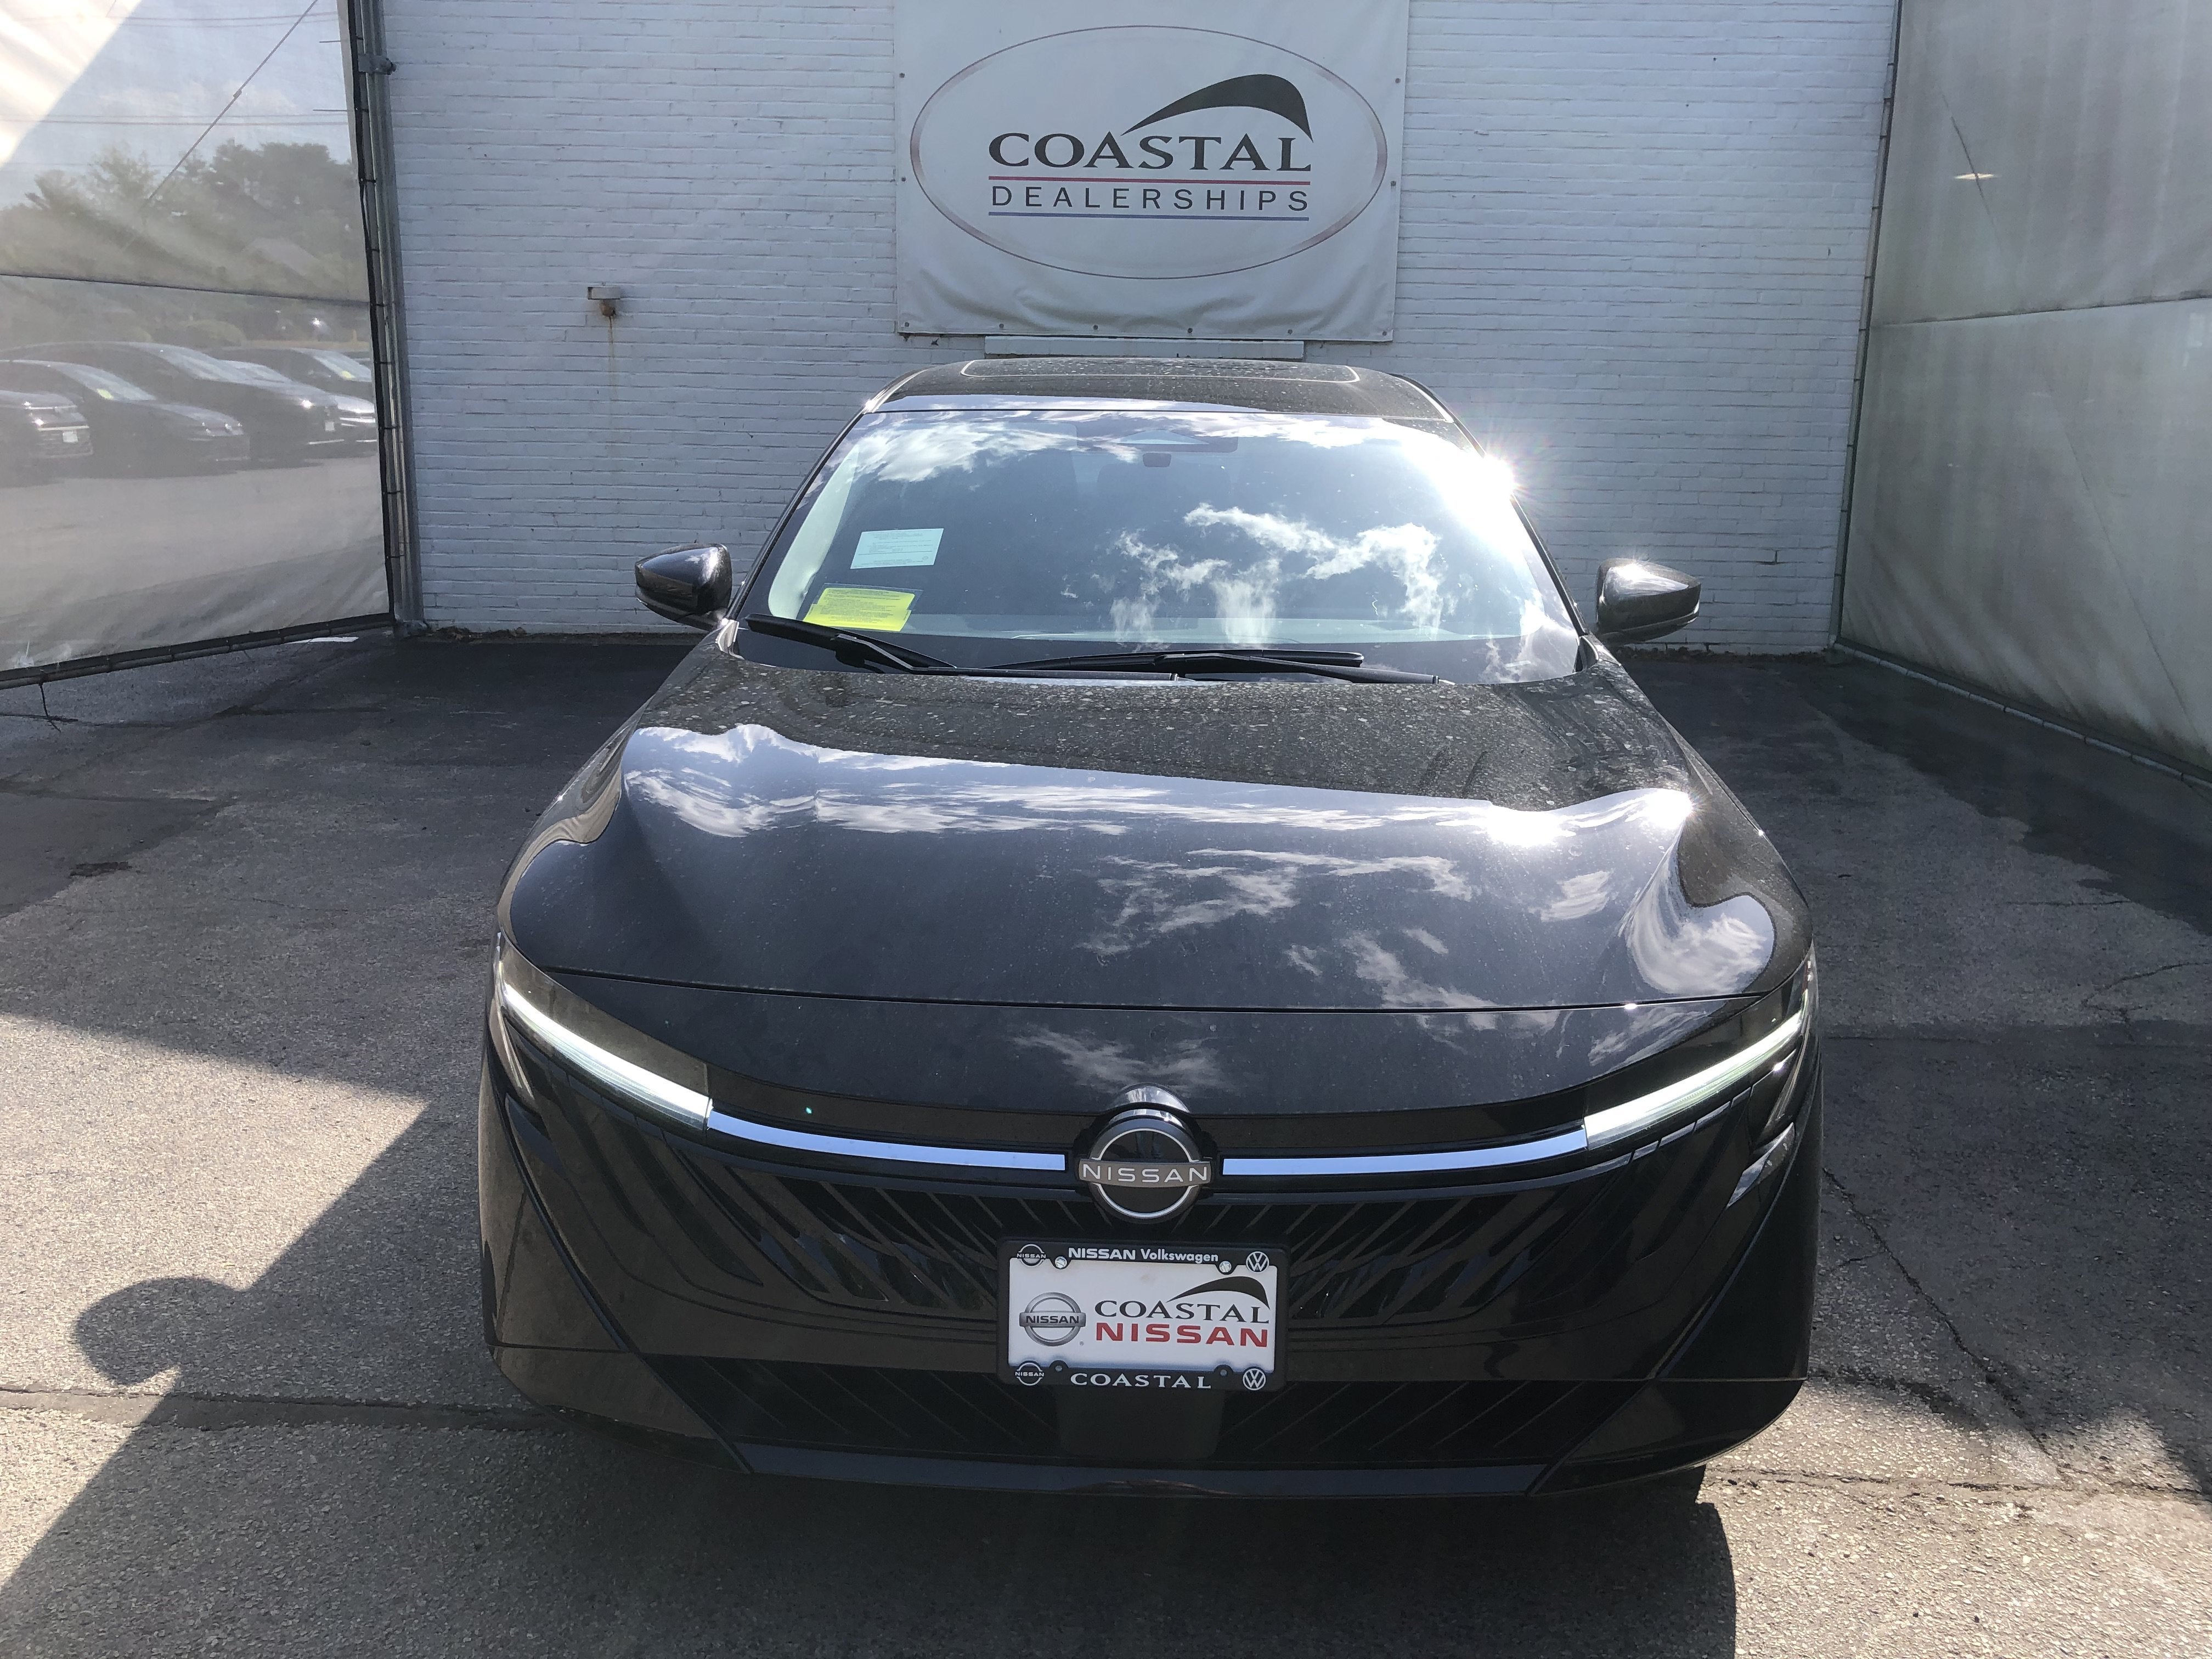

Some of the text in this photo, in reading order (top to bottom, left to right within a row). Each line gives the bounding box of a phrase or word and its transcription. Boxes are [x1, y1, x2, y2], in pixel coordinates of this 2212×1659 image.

[989, 131, 1311, 172] COASTAL
[992, 185, 1308, 212] DEALERSHIPS
[1082, 1164, 1207, 1183] NISSAN
[1068, 1247, 1219, 1263] NISSAN Volkswagen
[1025, 1314, 1080, 1324] NISSAN
[1094, 1300, 1269, 1324] COASTAL
[1096, 1322, 1268, 1347] NISSAN
[1070, 1373, 1211, 1389] COASTAL
